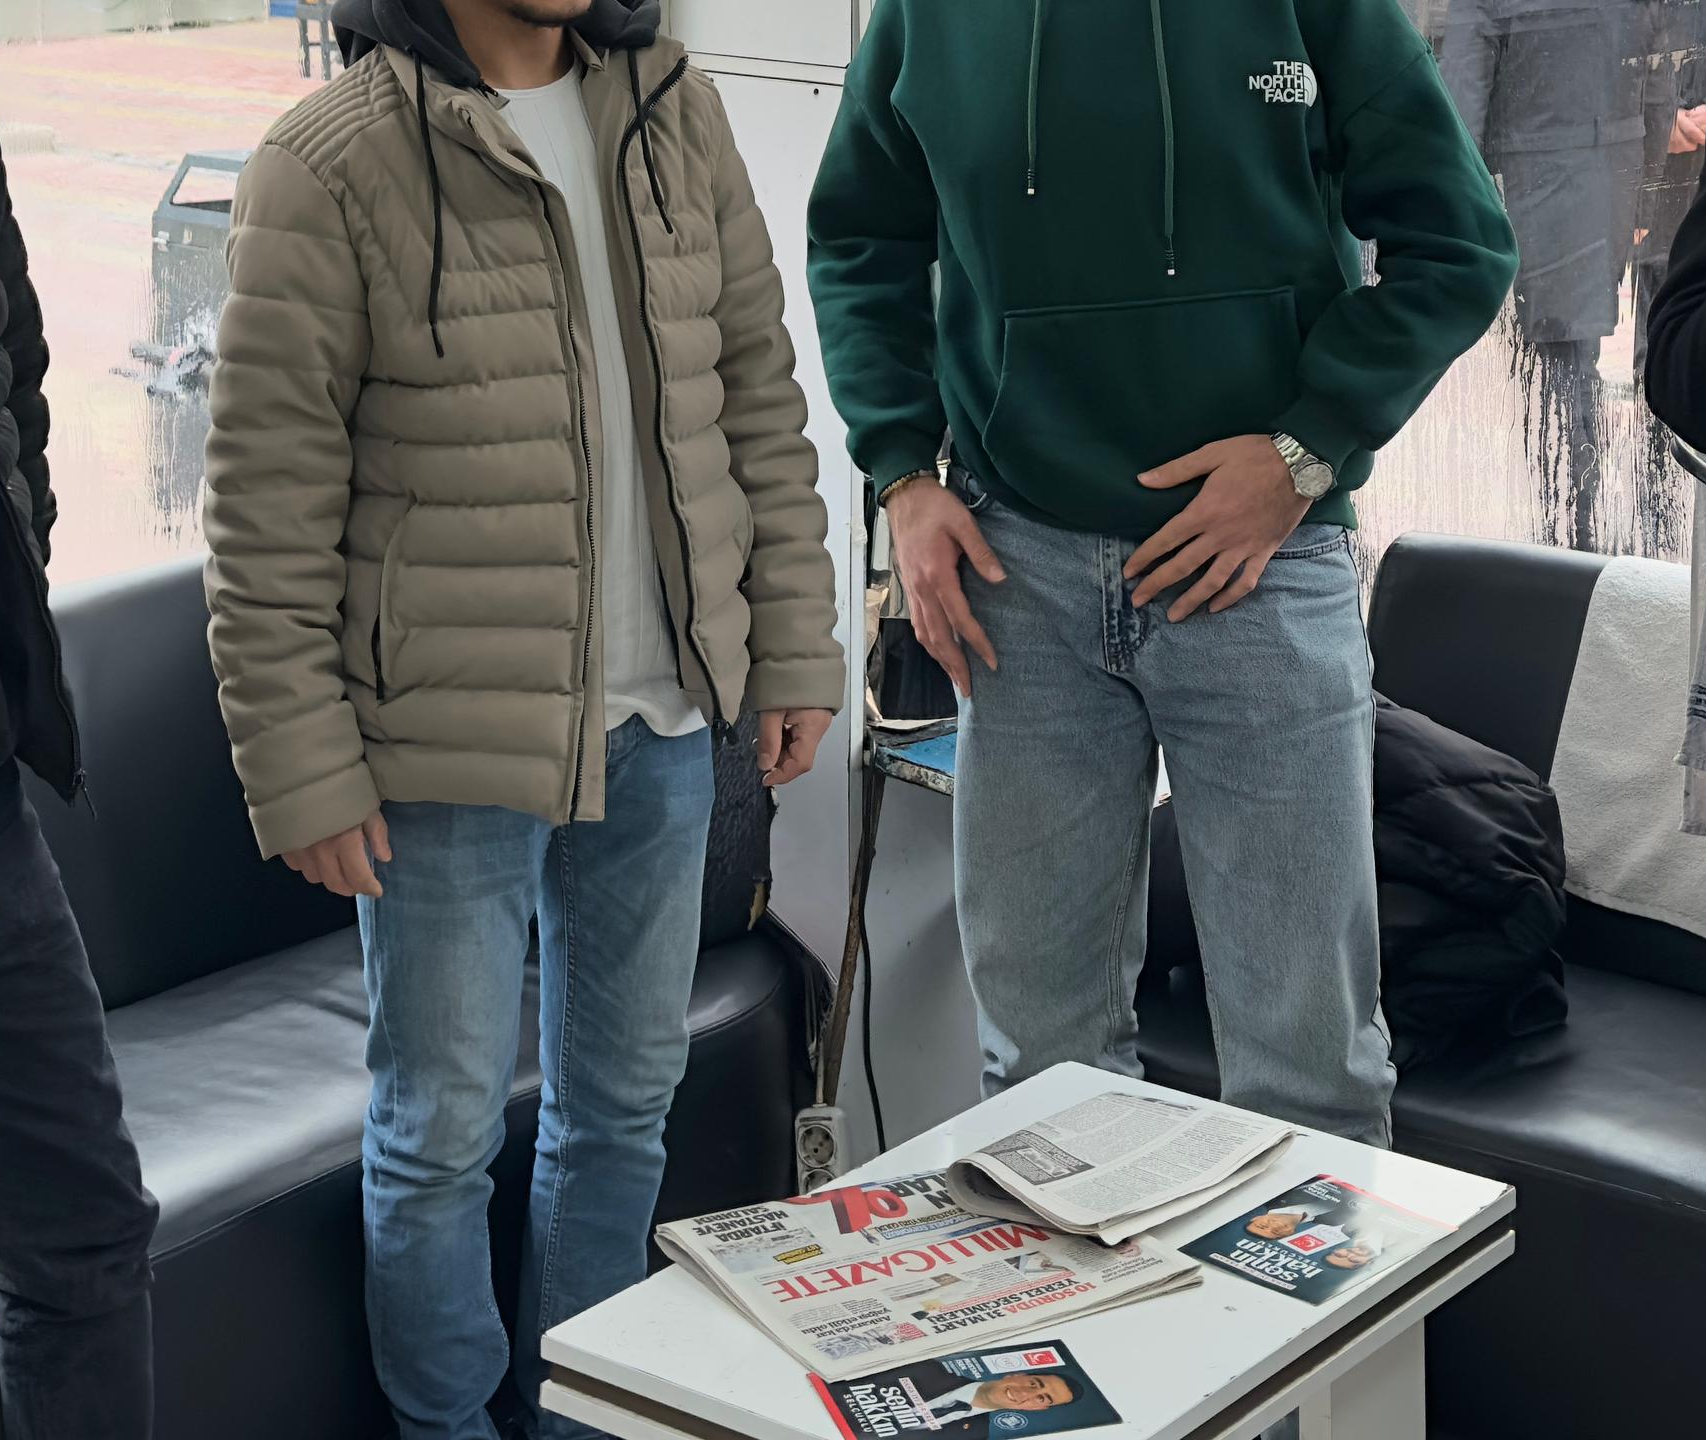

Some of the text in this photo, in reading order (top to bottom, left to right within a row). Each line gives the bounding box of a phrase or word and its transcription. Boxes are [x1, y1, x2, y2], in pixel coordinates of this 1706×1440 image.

[1273, 61, 1303, 75] THE
[1248, 74, 1303, 90] NORTH
[1265, 88, 1303, 103] FACE
[1019, 1278, 1081, 1300] YEREL
[1074, 1281, 1096, 1293] 10
[1005, 1289, 1076, 1314] SORUDA
[992, 1309, 1006, 1319] 31
[931, 1315, 988, 1334] MART
[849, 1383, 899, 1438] hakkın
[880, 1386, 921, 1429] senin
